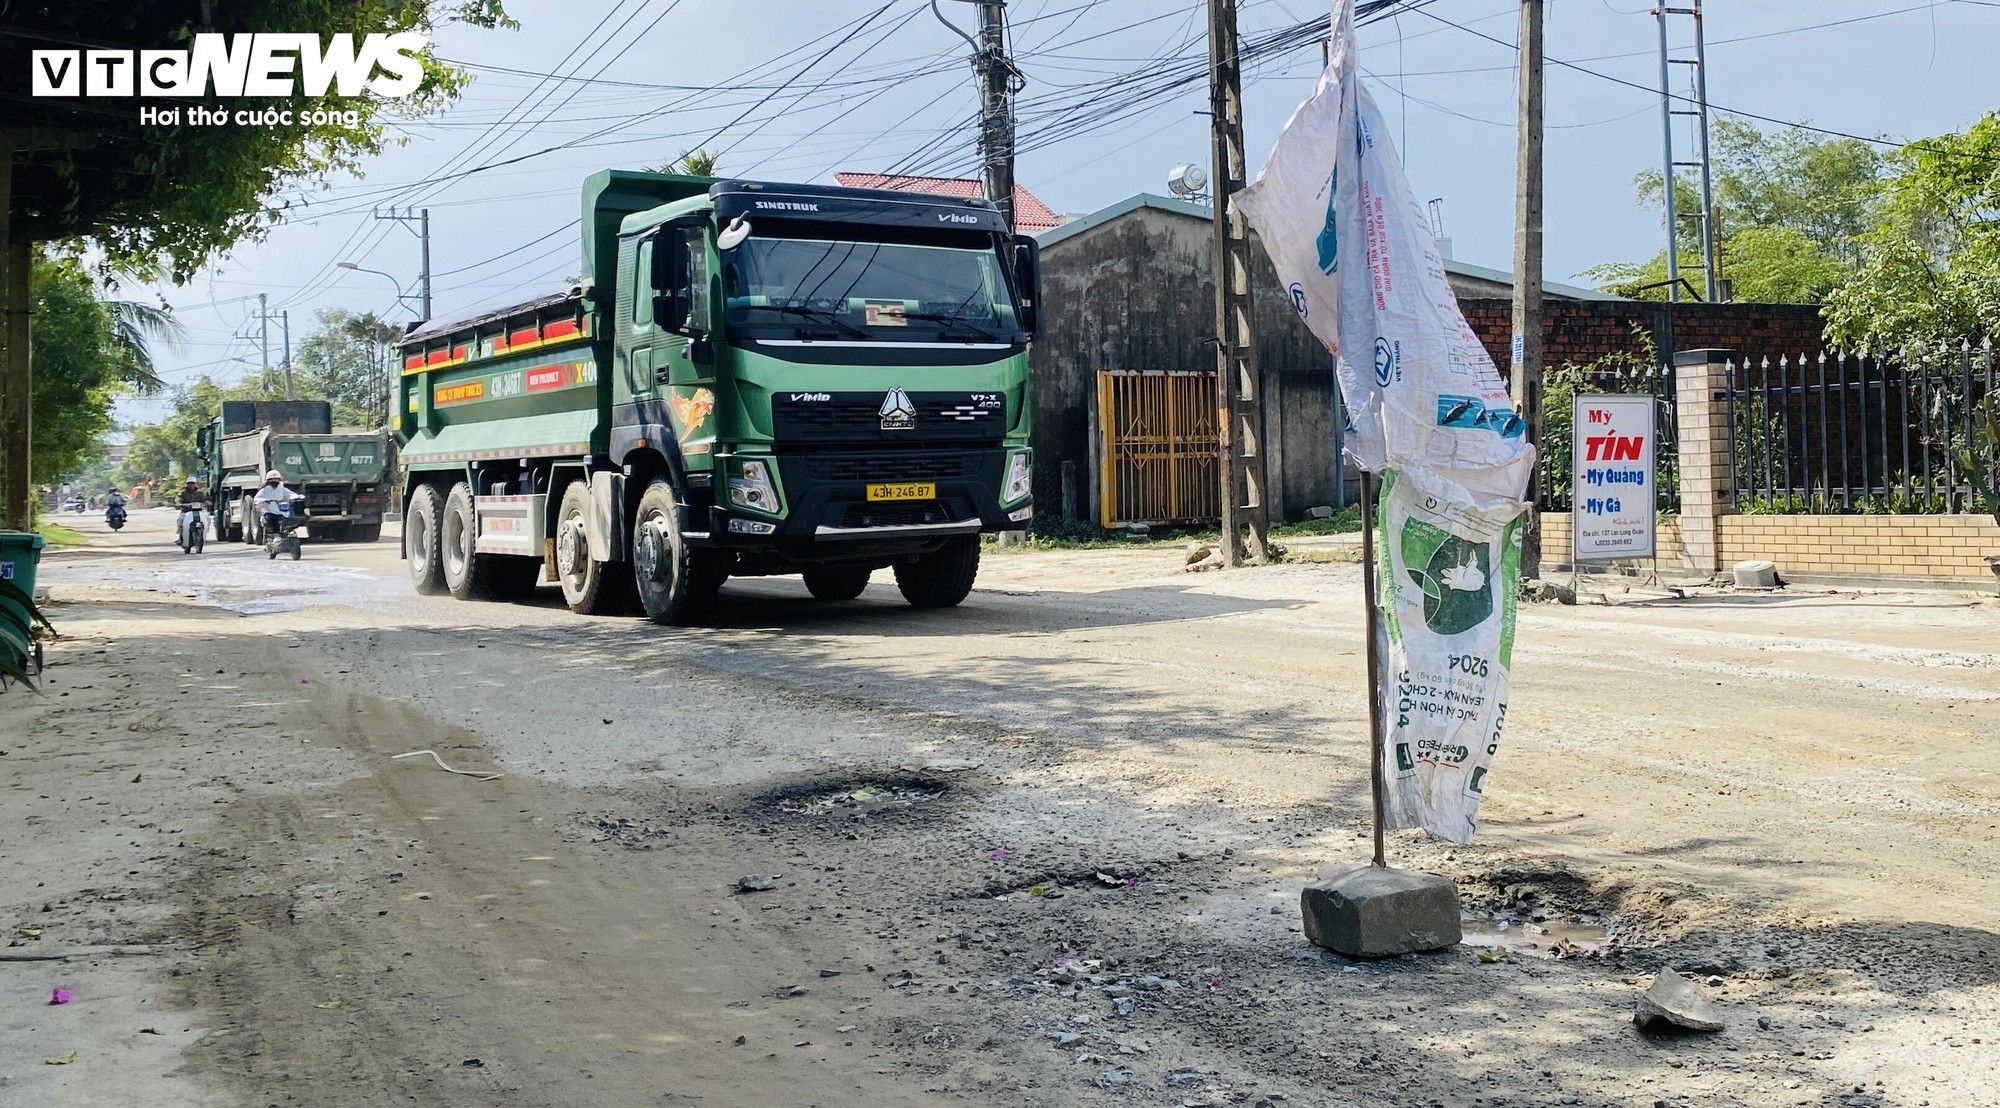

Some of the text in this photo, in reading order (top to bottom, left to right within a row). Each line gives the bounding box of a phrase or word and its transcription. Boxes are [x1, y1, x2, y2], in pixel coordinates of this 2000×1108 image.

[755, 201, 819, 212] SINOTRUK
[1586, 429, 1644, 461] TÍN
[1606, 466, 1644, 486] Quảng
[1606, 497, 1621, 513] Gà
[1447, 653, 1488, 678] 9204
[1430, 686, 1437, 698] 2
